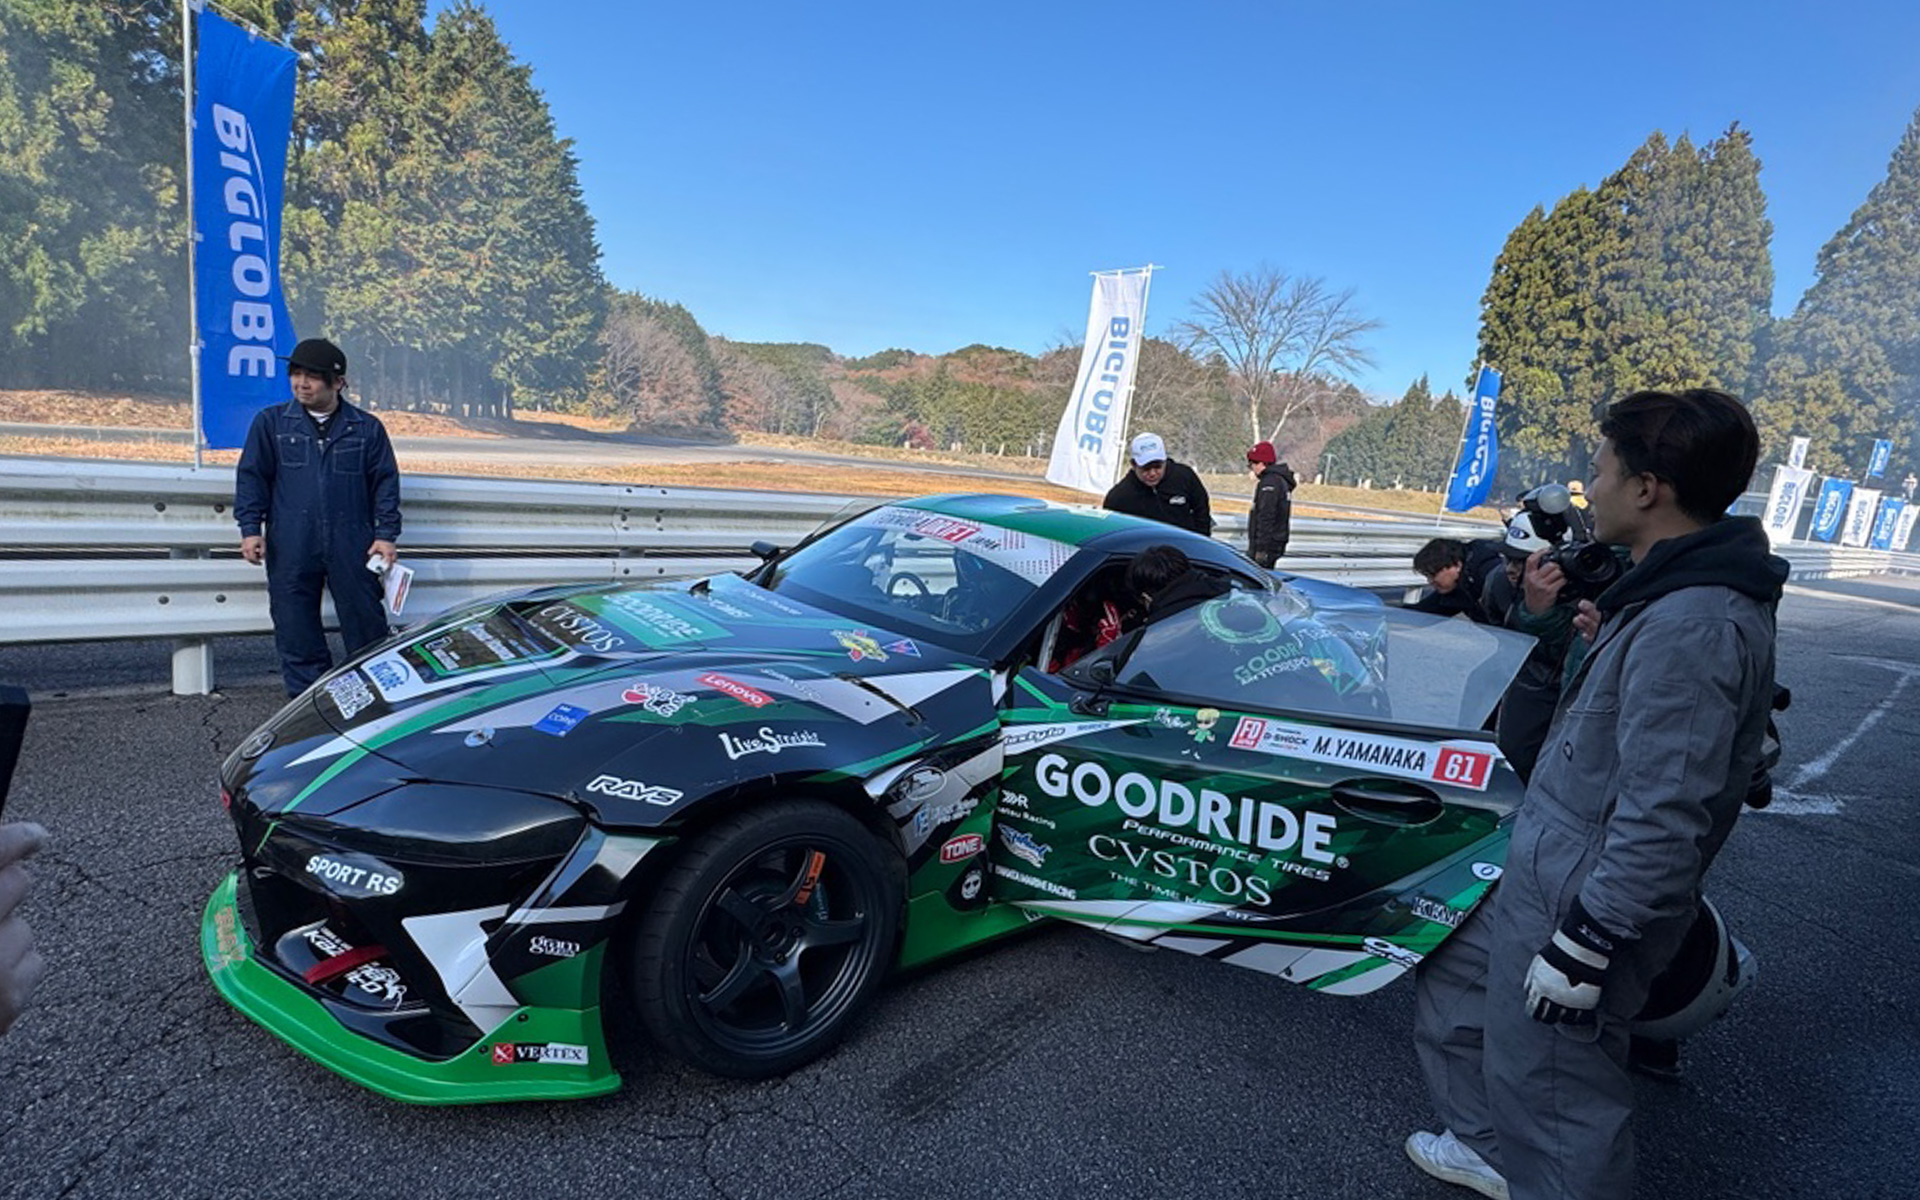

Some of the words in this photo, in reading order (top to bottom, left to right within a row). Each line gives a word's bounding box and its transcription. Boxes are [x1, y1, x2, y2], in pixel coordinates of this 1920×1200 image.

[212, 103, 276, 378] BIGLOBE
[540, 604, 626, 652] CVSTOS
[704, 673, 764, 706] Lenovo
[1312, 735, 1426, 772] M.YAMANAKA
[1444, 753, 1474, 782] 61
[586, 774, 684, 806] RAYS
[1035, 753, 1338, 865] GOODRIDE
[945, 837, 980, 859] TONE
[1122, 818, 1262, 865] PERFORMANCE
[1271, 857, 1332, 882] TIRES
[305, 856, 366, 885] SPORT
[366, 872, 400, 894] RS
[1088, 833, 1272, 906] CVSTOS
[1109, 871, 1138, 886] THE
[1143, 881, 1181, 899] TIME
[516, 1046, 583, 1060] VERTEX
